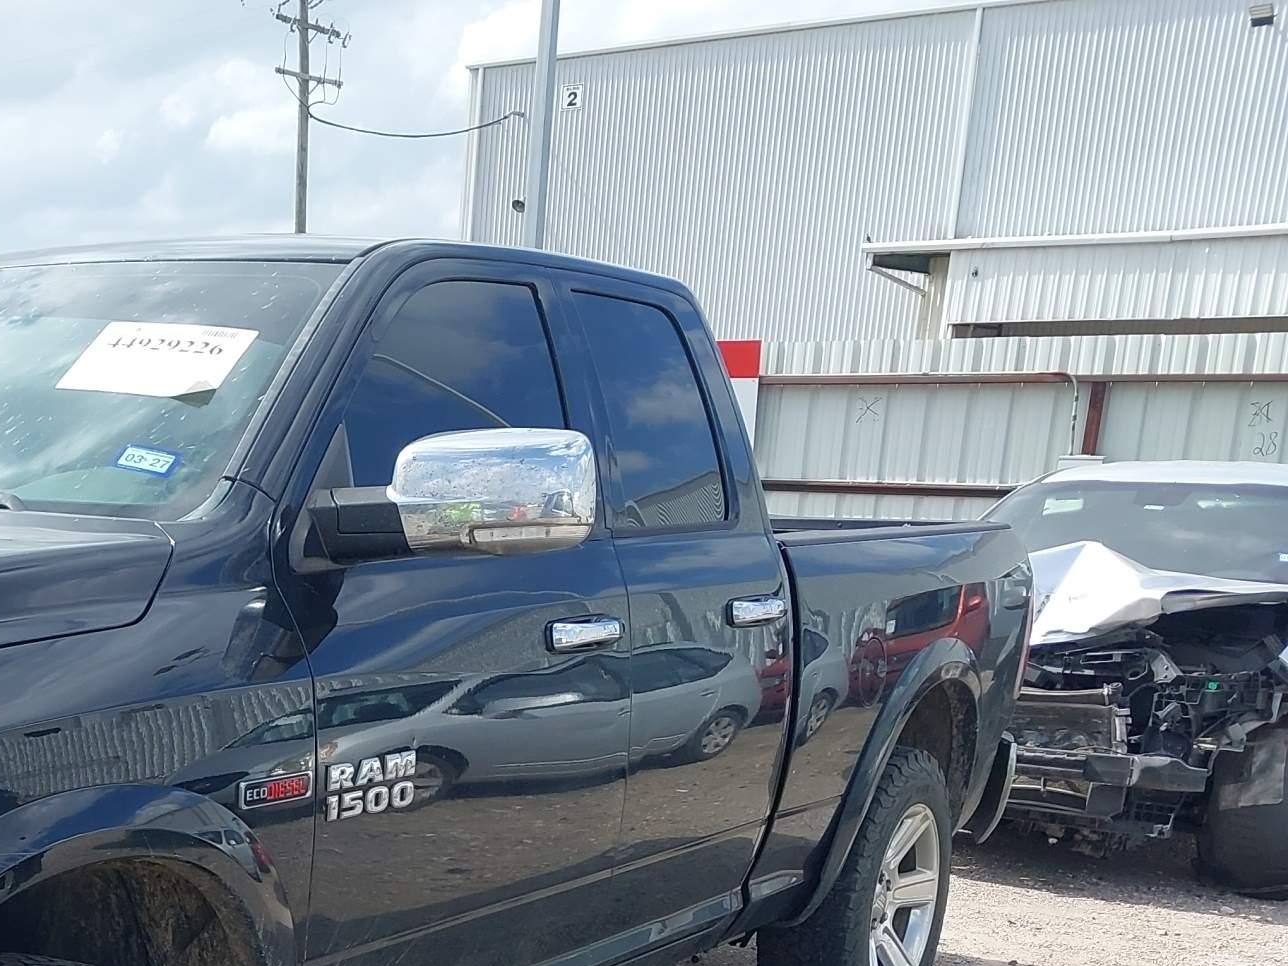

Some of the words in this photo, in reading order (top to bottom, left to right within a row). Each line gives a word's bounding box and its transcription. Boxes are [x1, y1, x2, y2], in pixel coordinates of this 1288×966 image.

[566, 91, 578, 107] 2
[107, 336, 224, 356] 44929226
[149, 458, 171, 469] 27
[326, 750, 416, 792] RAM
[326, 780, 415, 822] 1500
